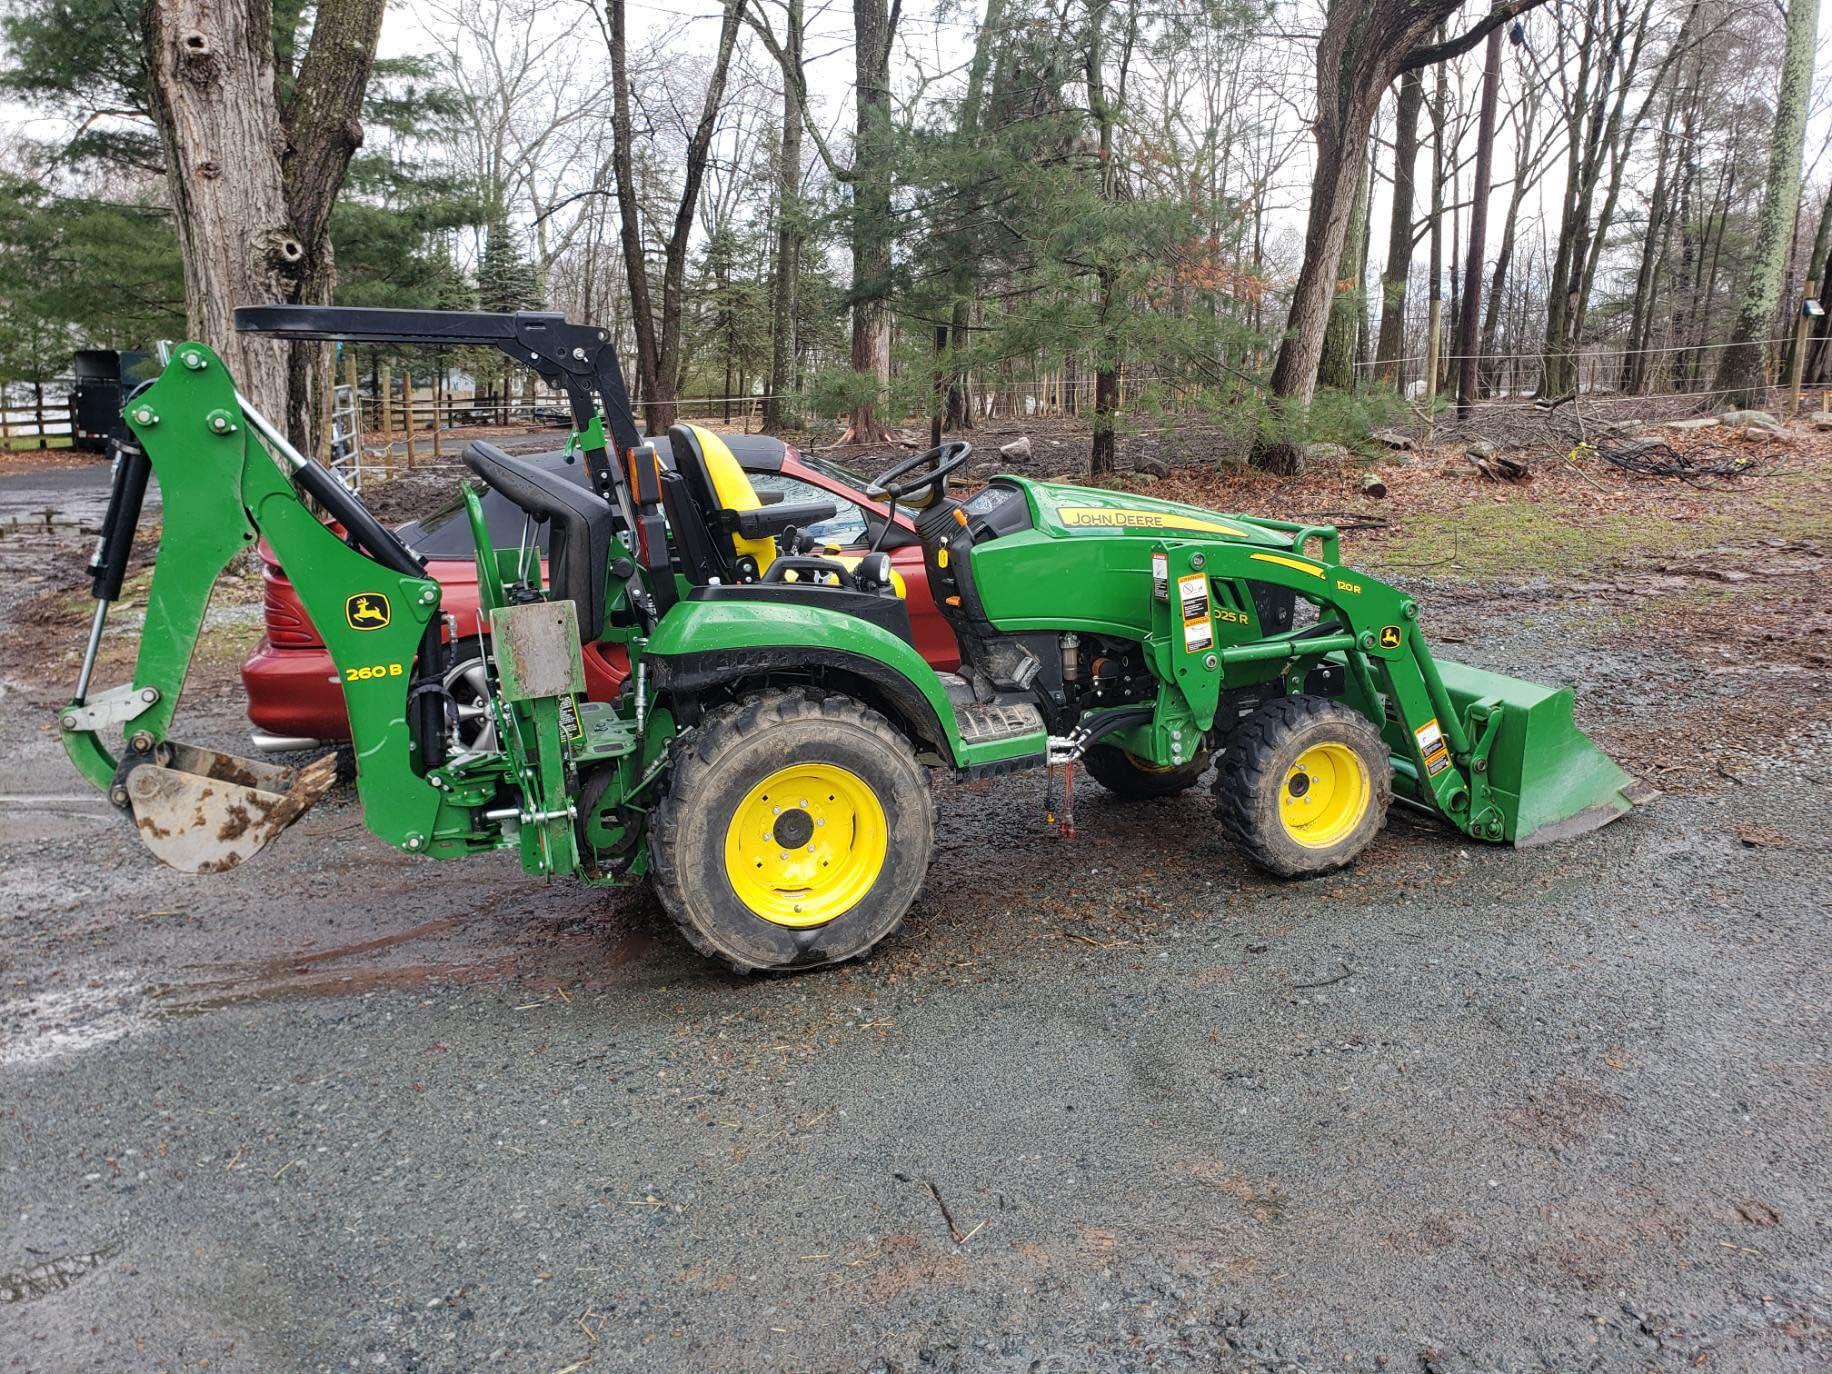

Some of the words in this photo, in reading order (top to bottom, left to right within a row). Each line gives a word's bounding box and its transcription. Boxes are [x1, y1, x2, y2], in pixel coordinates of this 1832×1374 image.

[1072, 512, 1112, 525] JOHN
[1115, 512, 1163, 527] DEERE
[1336, 580, 1353, 592] 120
[1214, 609, 1237, 622] 025
[1239, 613, 1249, 625] R
[346, 665, 387, 682] 260
[389, 663, 403, 676] B
